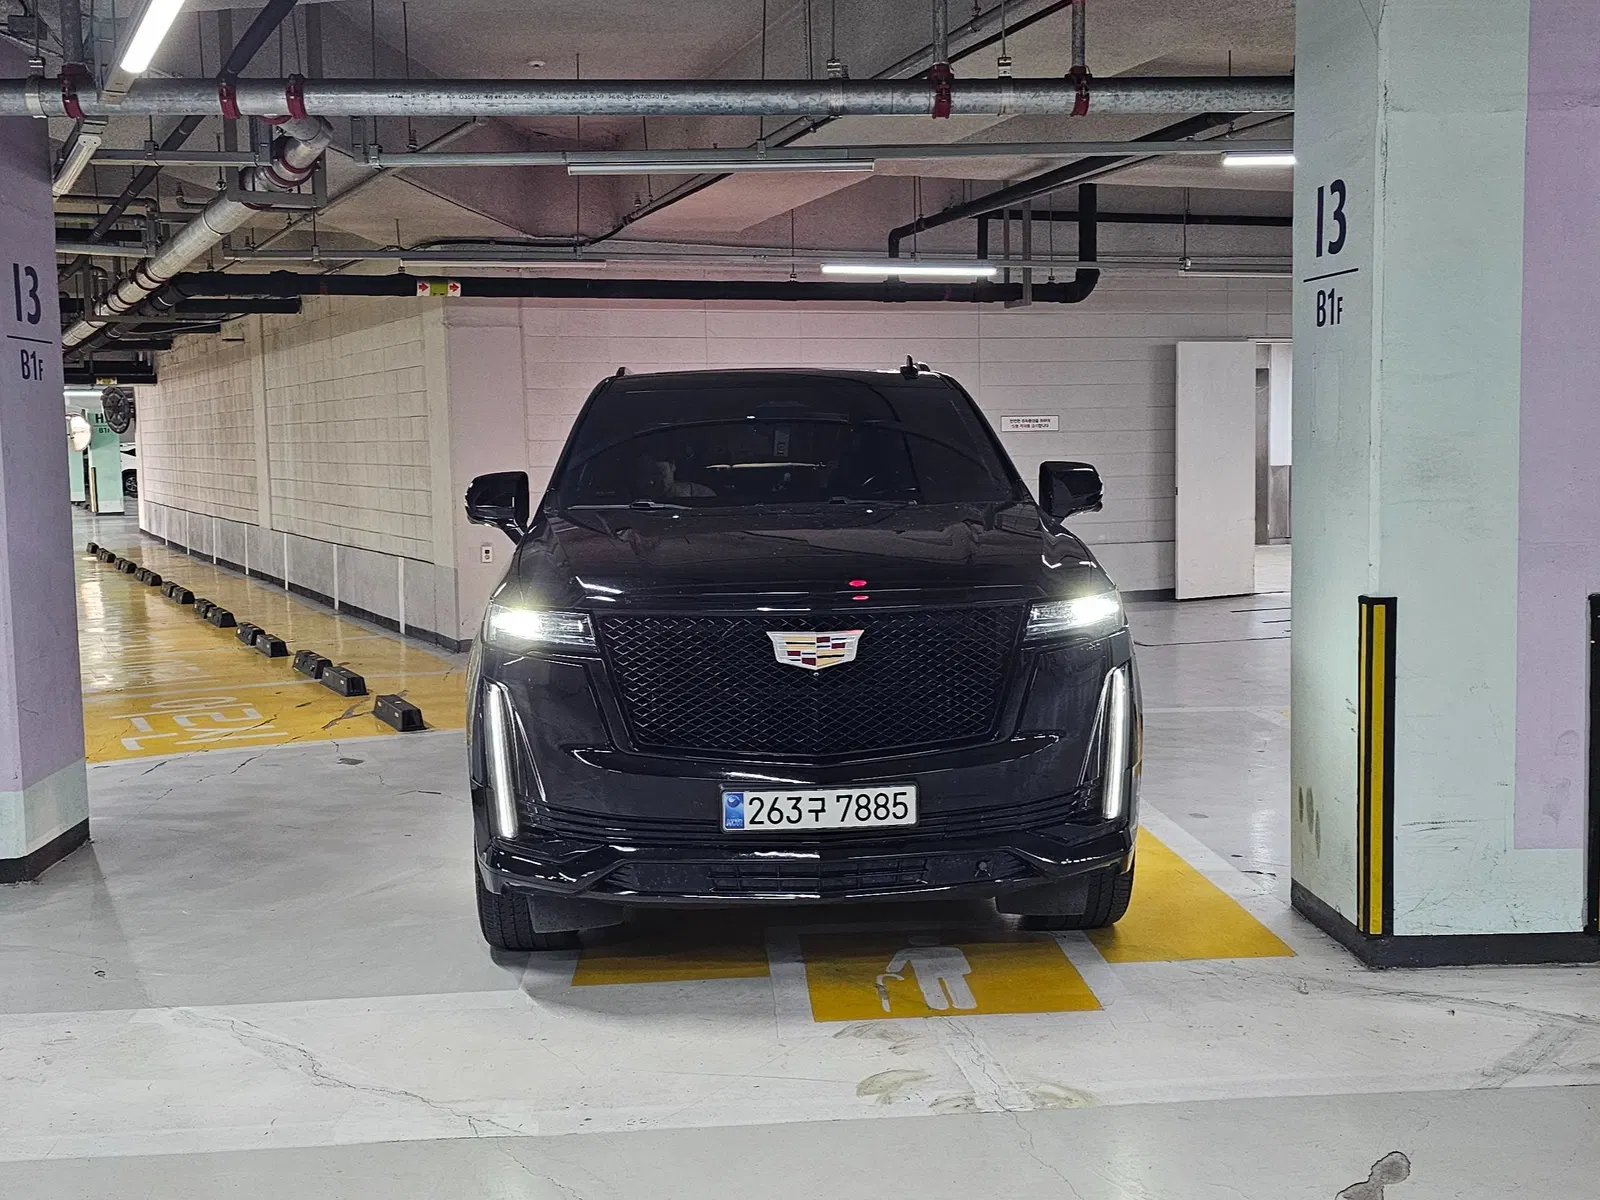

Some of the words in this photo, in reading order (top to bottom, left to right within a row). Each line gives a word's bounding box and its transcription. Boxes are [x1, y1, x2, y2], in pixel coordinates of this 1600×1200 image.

[1316, 287, 1344, 328] B1F
[20, 348, 44, 381] B1F
[748, 796, 826, 825] 263구
[836, 792, 908, 822] 7885
